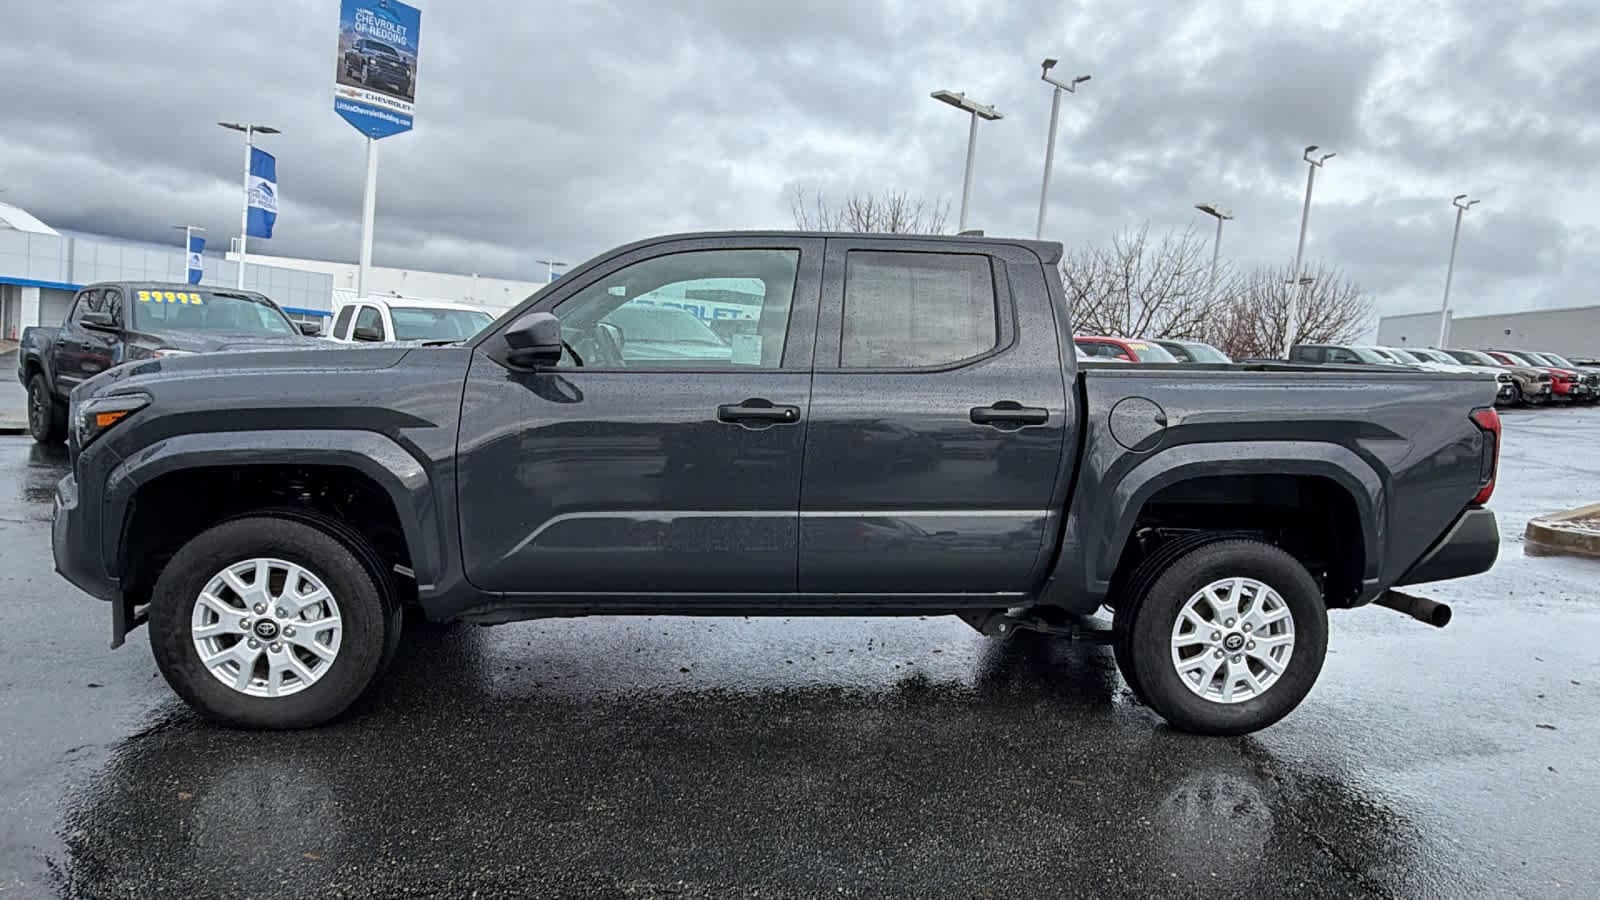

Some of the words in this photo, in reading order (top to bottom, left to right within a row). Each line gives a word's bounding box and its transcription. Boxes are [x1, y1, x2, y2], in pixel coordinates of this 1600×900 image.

[354, 22, 366, 33] OF
[369, 26, 408, 46] REDDING
[355, 12, 408, 36] CHEVROLET
[366, 93, 411, 111] CHEVROLET
[137, 290, 204, 305] 39995
